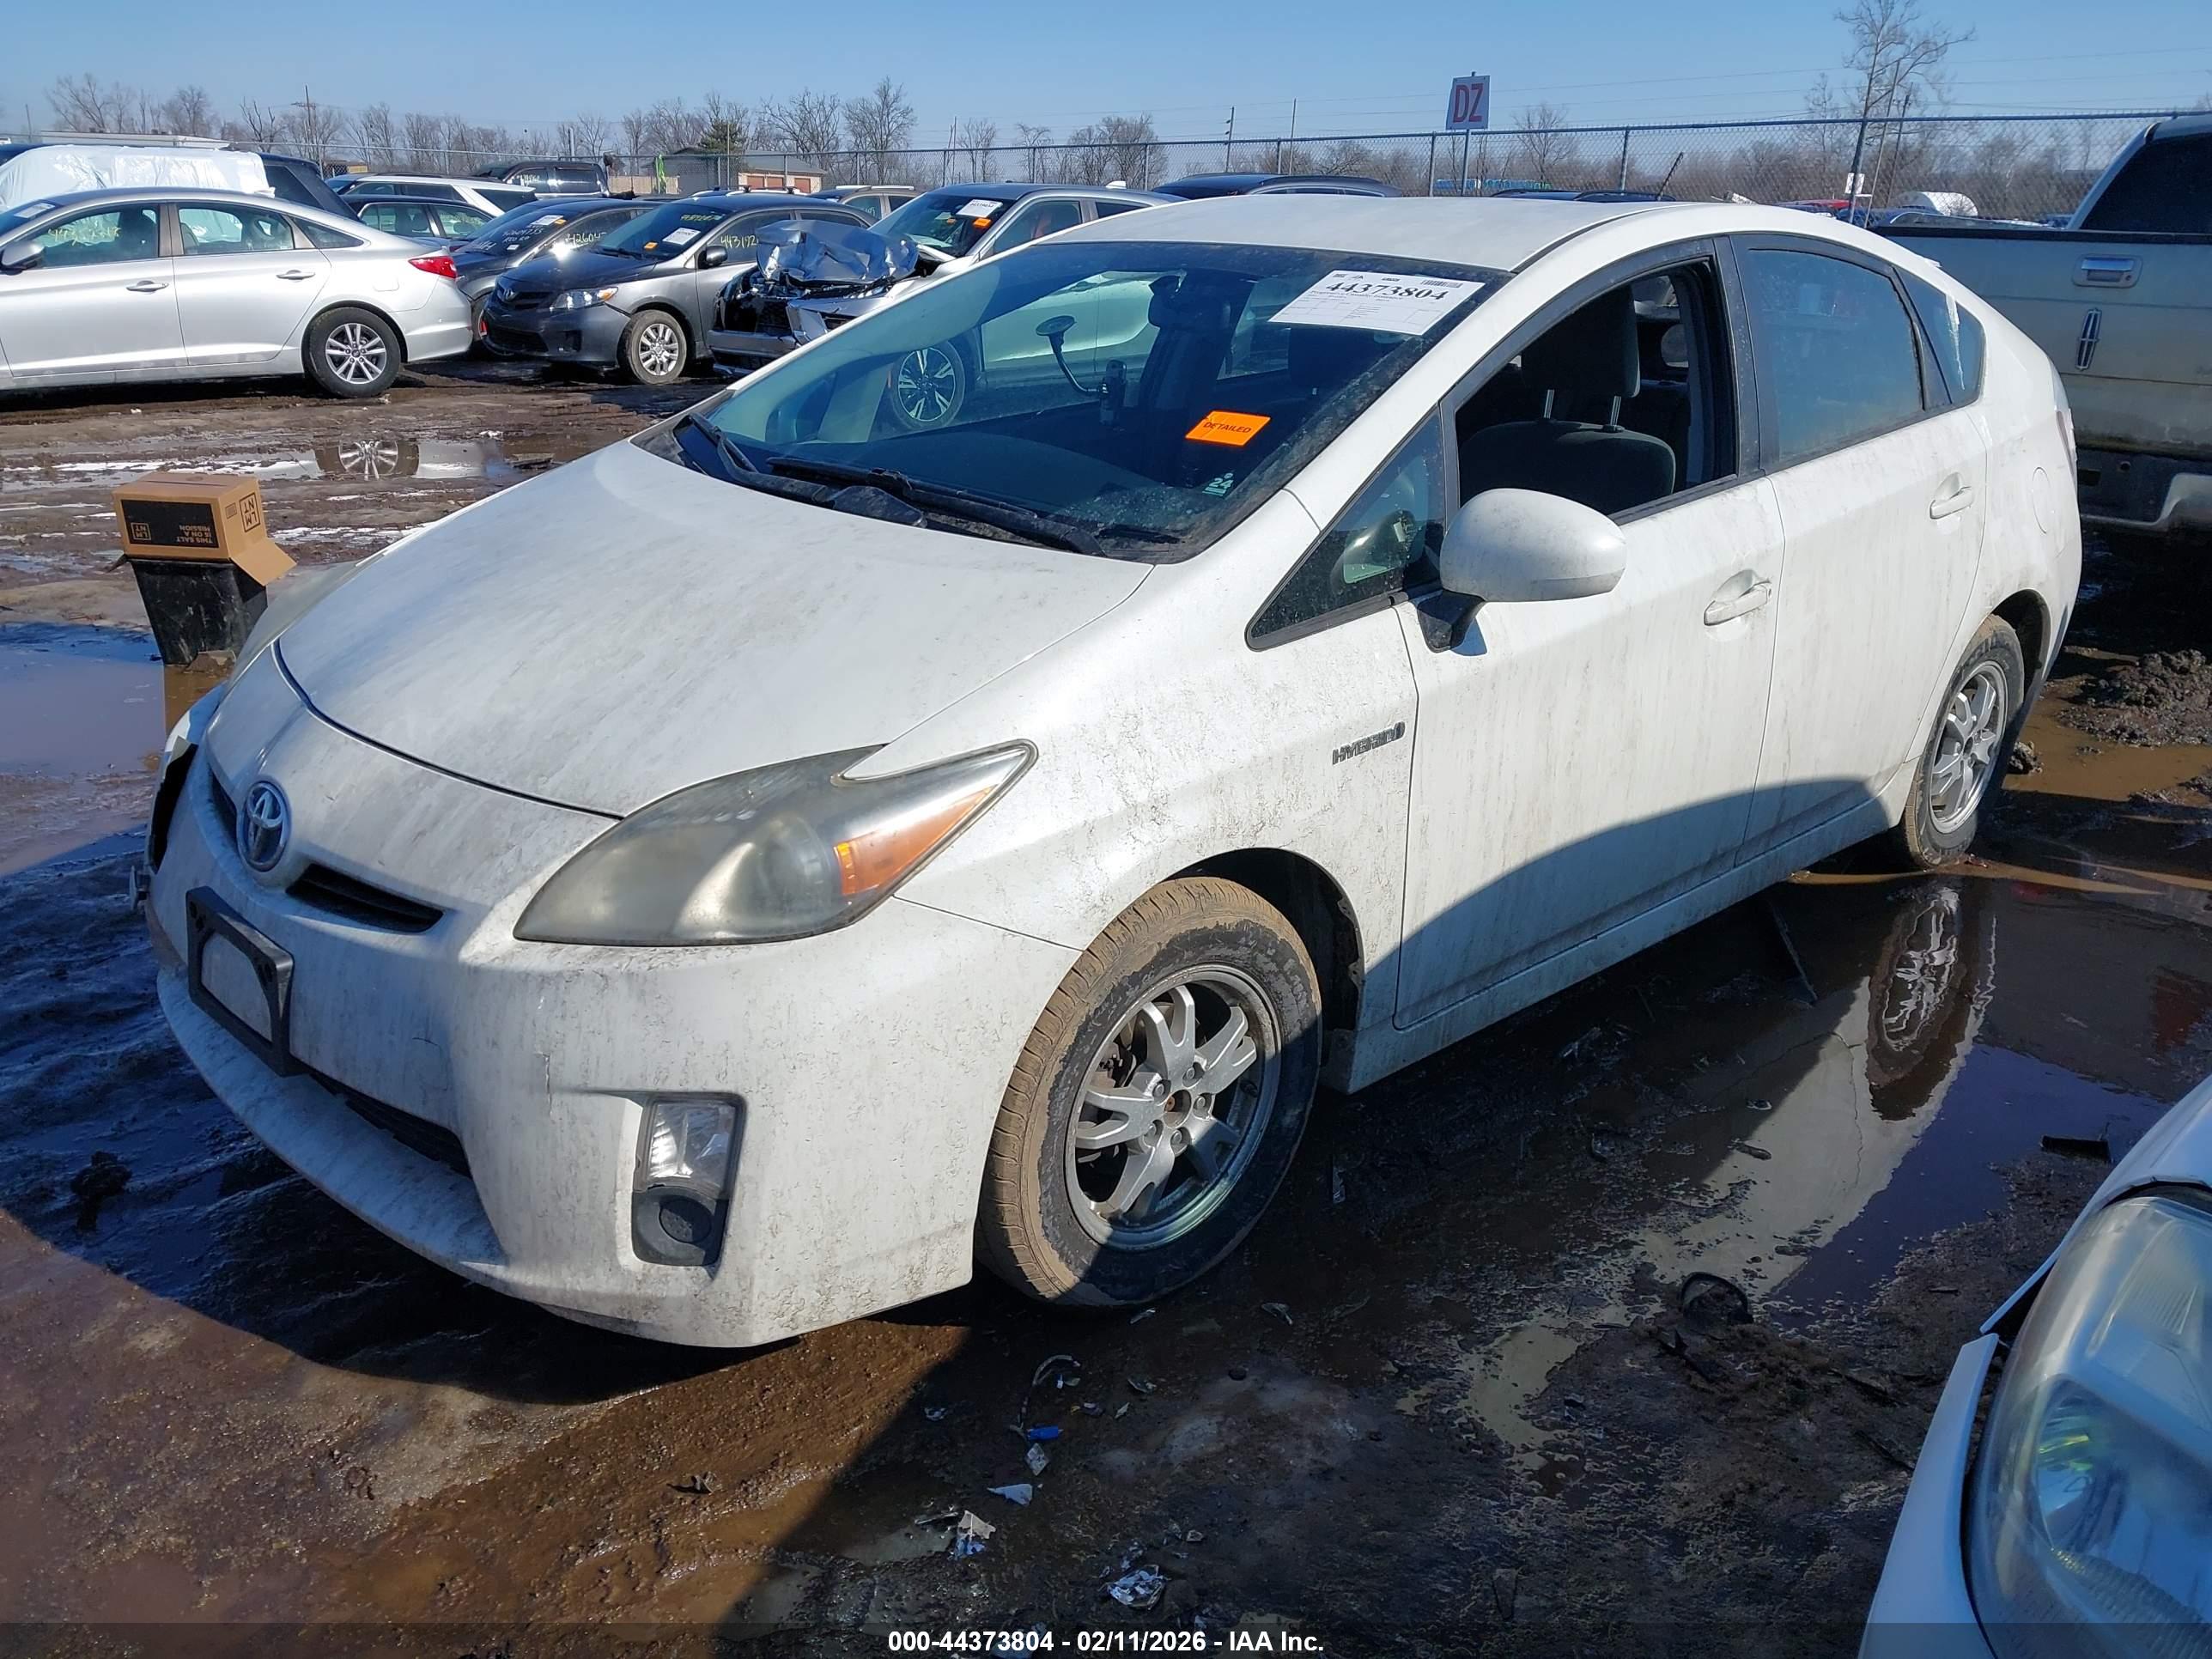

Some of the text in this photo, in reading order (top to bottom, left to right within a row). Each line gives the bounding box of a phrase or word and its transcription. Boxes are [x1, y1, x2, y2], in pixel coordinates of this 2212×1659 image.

[1453, 83, 1484, 123] DZ
[1325, 282, 1449, 301] 44373804
[1203, 422, 1252, 433] DETAILED
[243, 497, 255, 514] NT
[245, 512, 258, 527] LM
[1332, 725, 1400, 765] HYBRID
